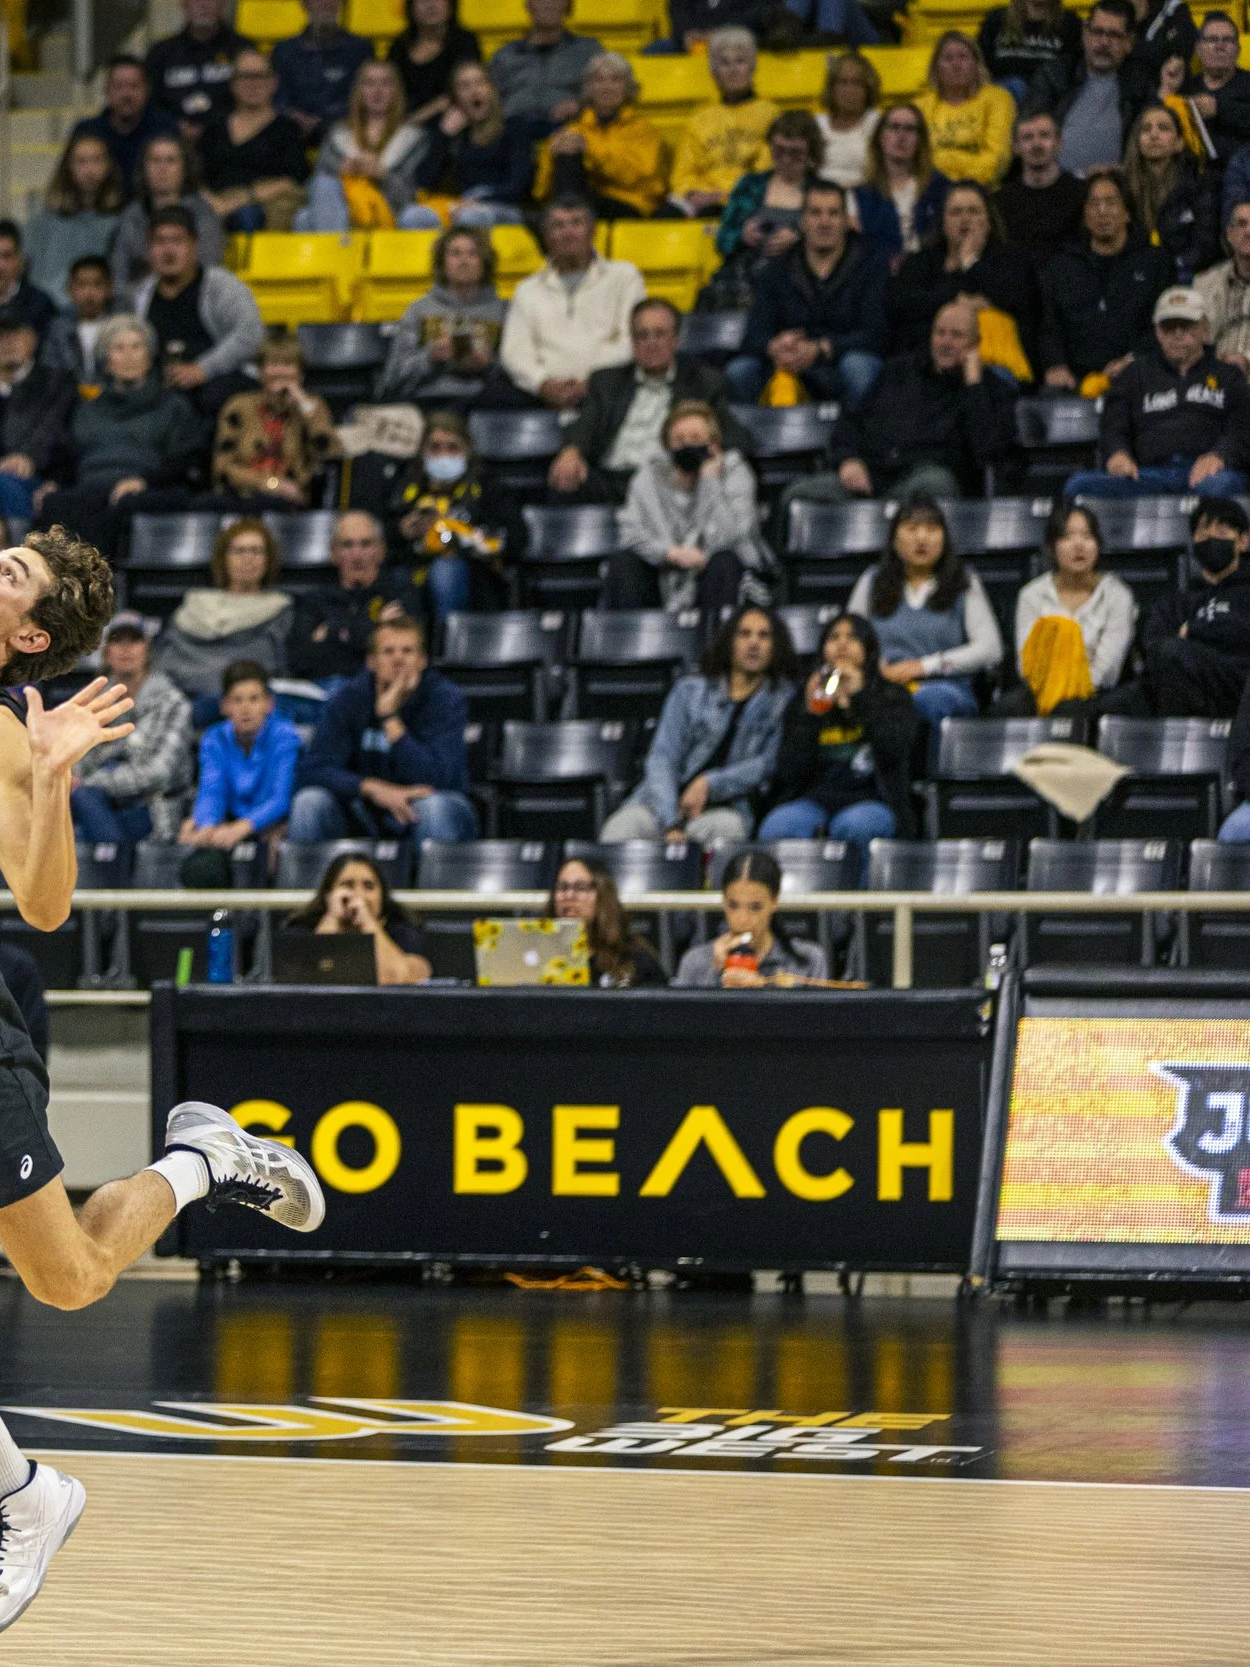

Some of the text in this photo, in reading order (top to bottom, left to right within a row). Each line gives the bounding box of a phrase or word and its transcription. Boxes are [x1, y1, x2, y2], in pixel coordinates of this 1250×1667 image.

[453, 1104, 955, 1201] BEACH
[656, 1406, 953, 1430] THE
[543, 1436, 983, 1462] WEST
